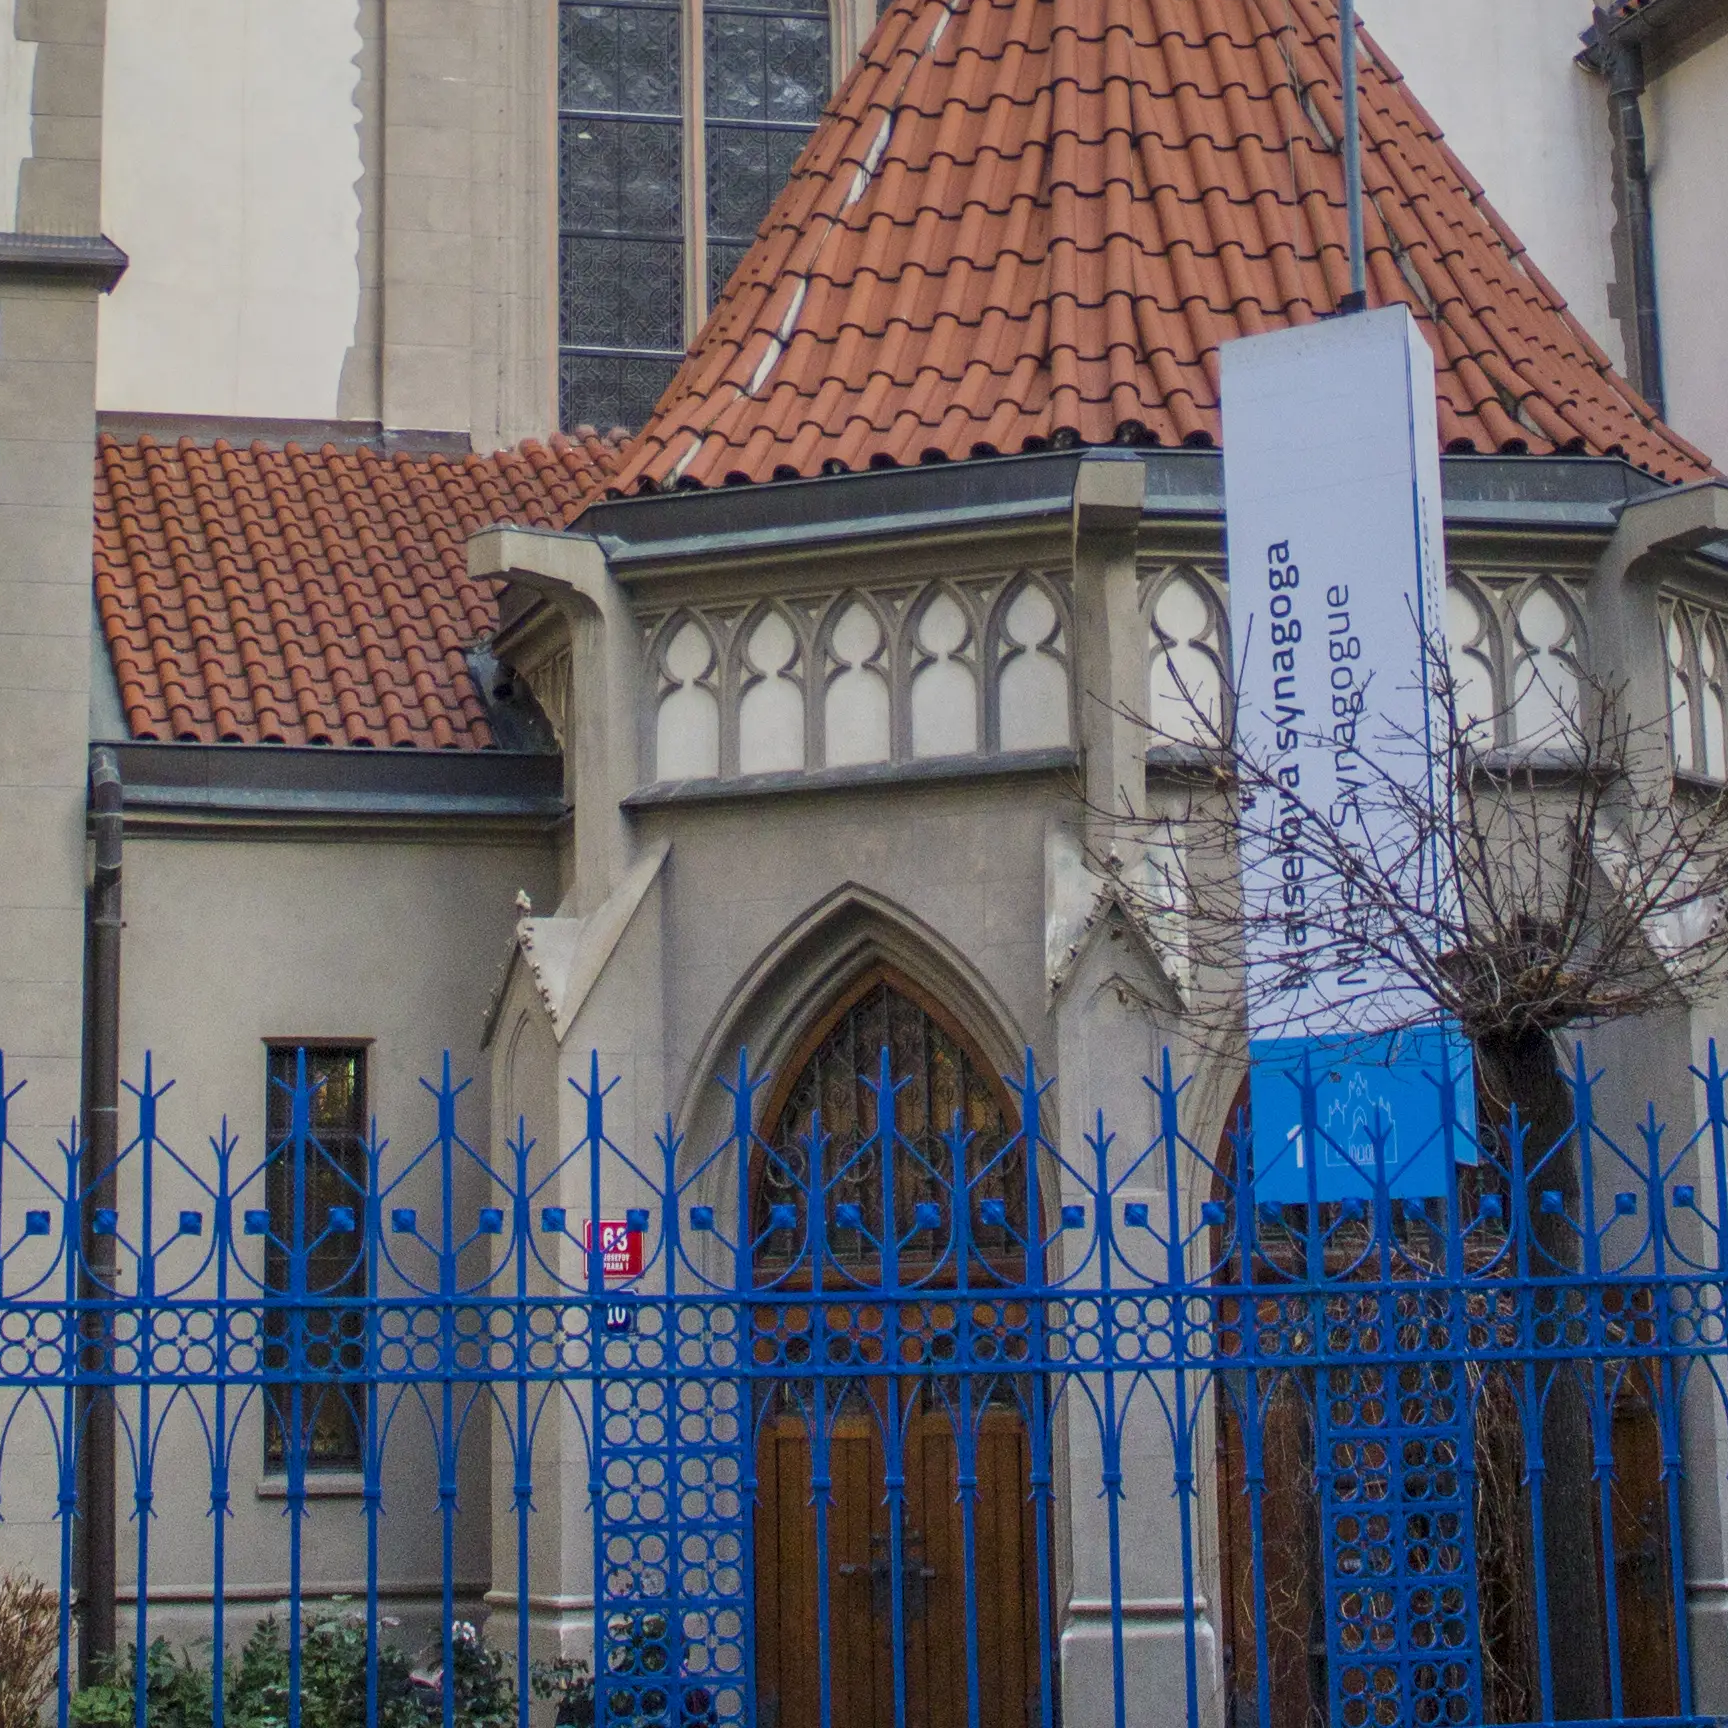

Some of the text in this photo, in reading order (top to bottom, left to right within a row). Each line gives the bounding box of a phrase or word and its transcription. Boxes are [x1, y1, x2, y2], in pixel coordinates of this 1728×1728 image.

[1267, 539, 1305, 751] synagoga
[1326, 584, 1368, 828] Synagogue
[1286, 1124, 1304, 1169] 1
[603, 1227, 628, 1252] 63
